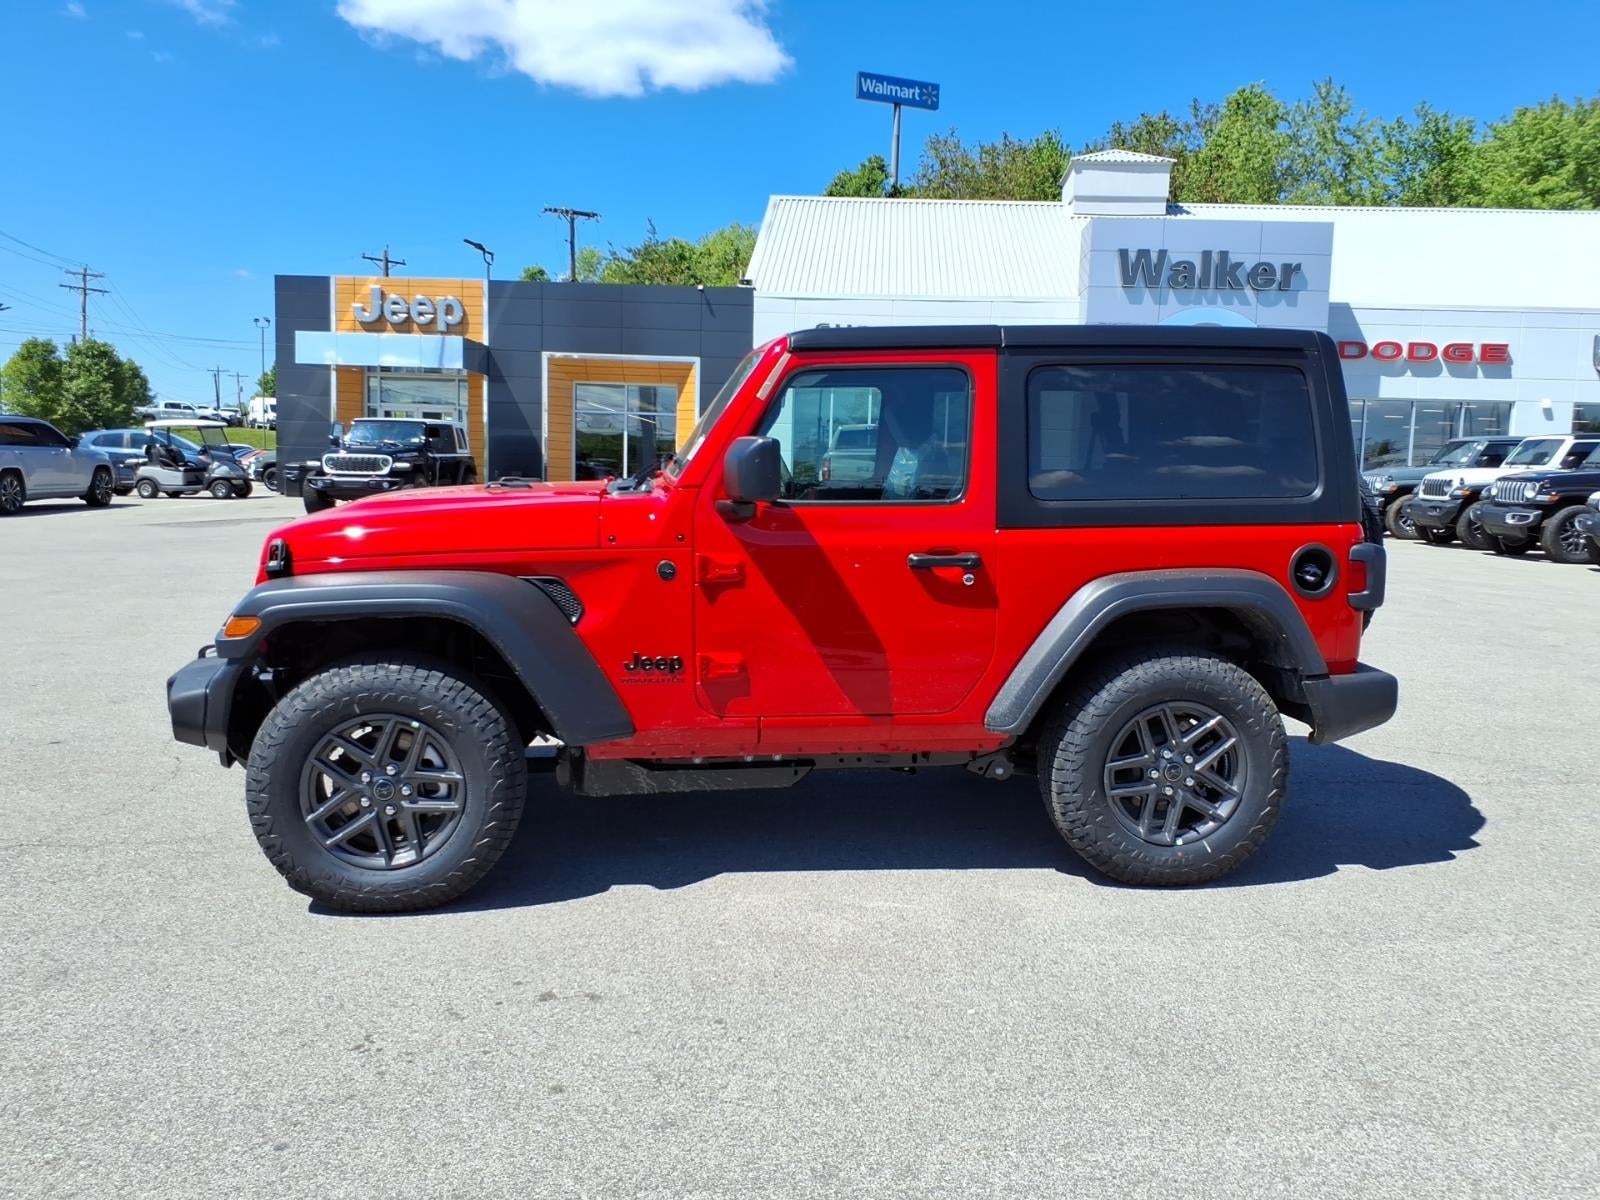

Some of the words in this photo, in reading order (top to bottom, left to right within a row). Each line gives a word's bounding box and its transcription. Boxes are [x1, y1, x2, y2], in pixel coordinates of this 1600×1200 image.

[861, 77, 920, 100] Walmart
[1118, 248, 1302, 290] Walker
[352, 284, 464, 332] Jeep
[1337, 341, 1509, 364] DODGE
[623, 651, 683, 674] Jeep
